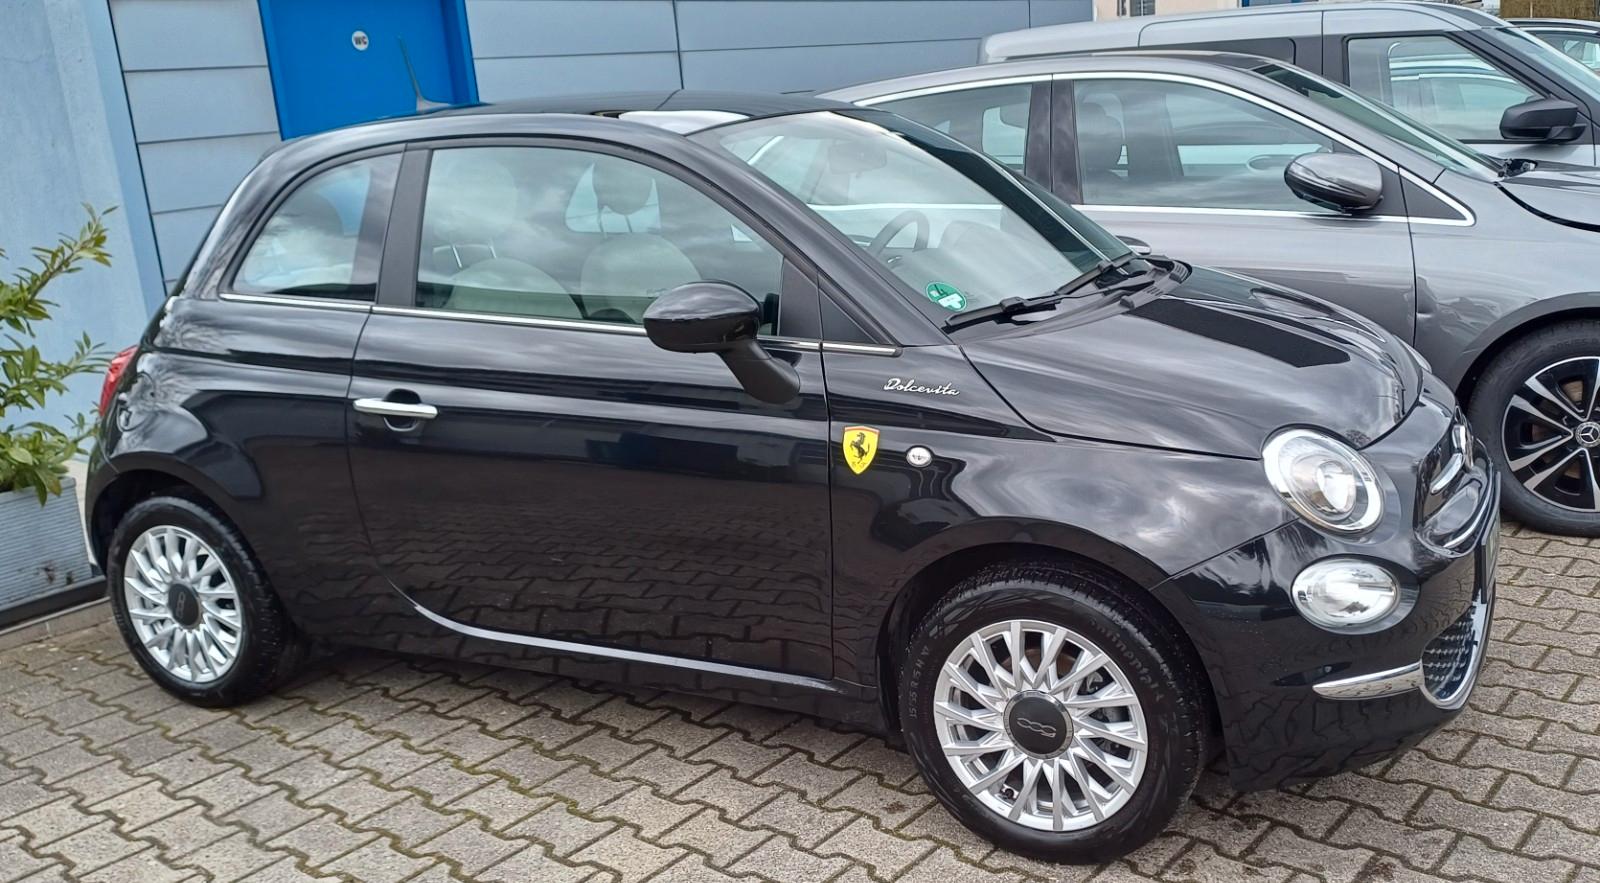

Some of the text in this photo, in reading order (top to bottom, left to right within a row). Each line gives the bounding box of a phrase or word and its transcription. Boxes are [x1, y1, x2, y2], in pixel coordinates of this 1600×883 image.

[353, 36, 368, 46] WC
[883, 377, 960, 396] Dolcevita
[1085, 613, 1160, 690] ontinental
